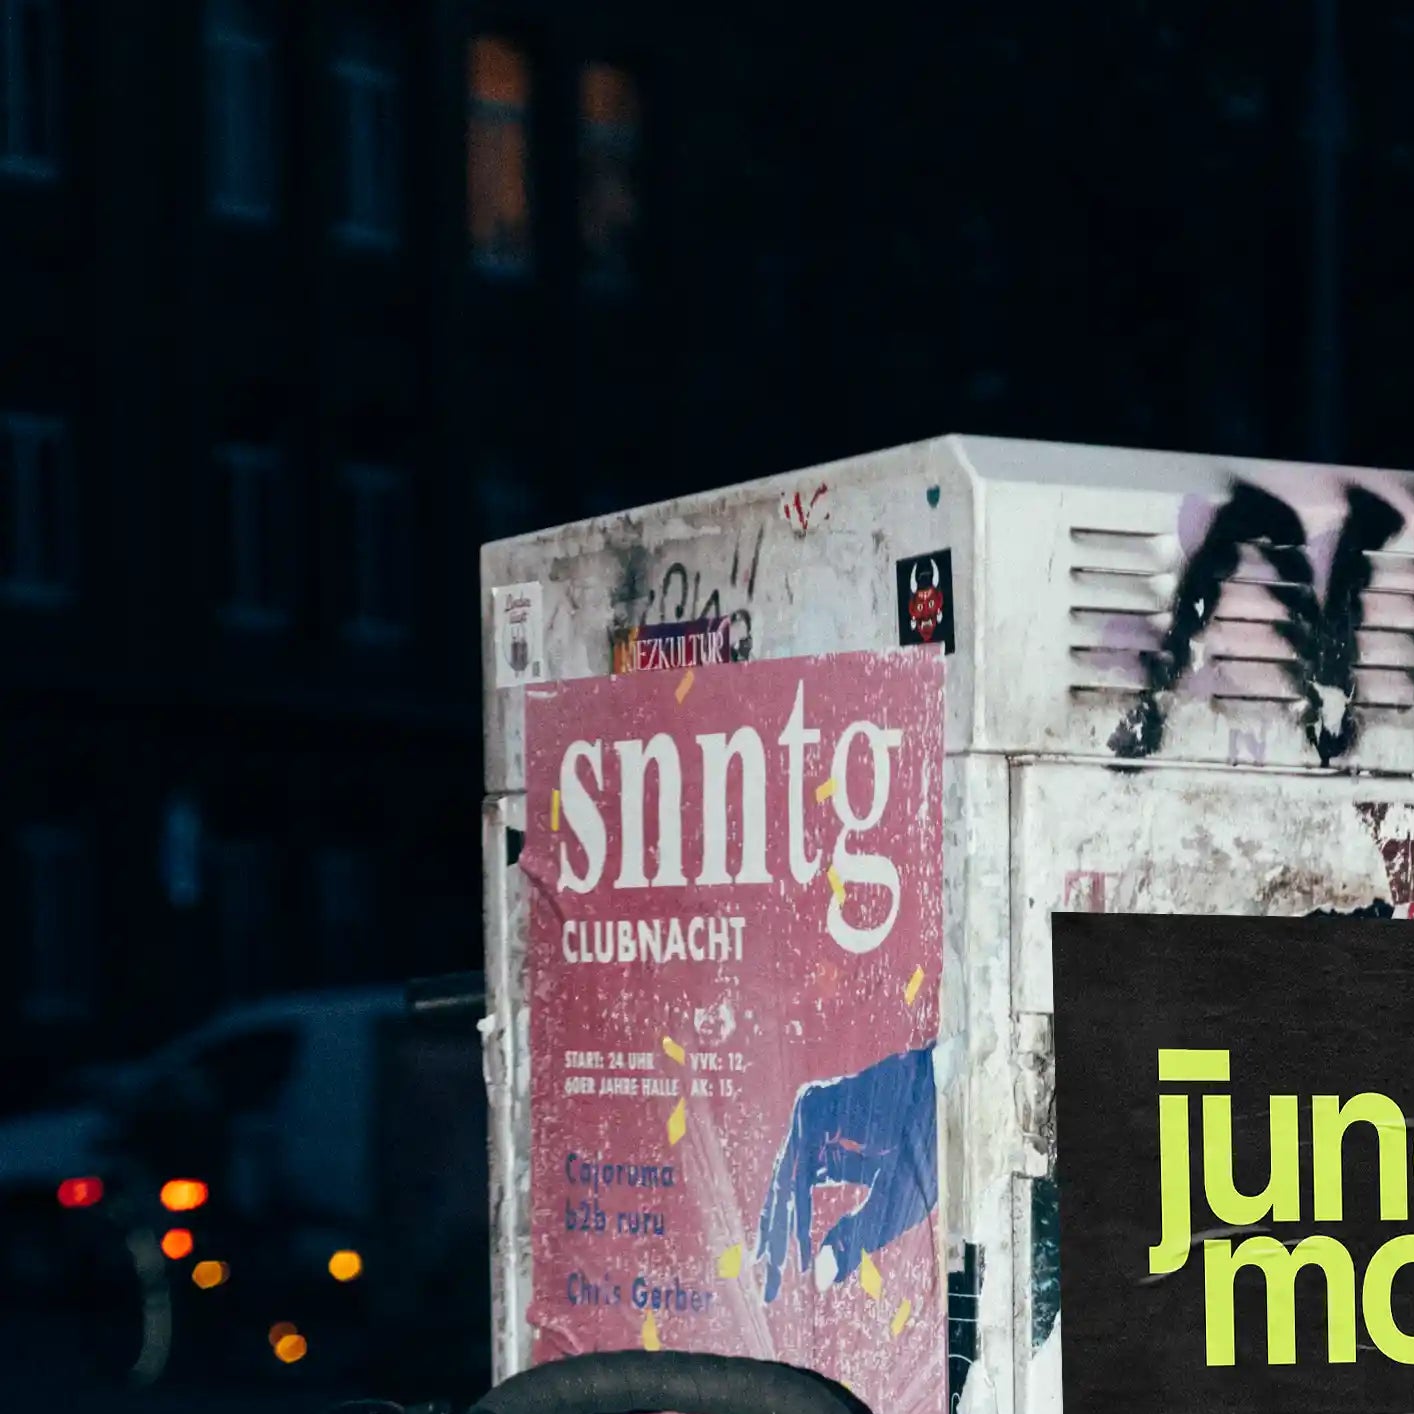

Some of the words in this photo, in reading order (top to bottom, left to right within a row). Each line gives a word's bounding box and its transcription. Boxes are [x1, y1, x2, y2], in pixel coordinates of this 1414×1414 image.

[557, 680, 904, 953] snntg
[562, 916, 746, 964] CLUBNACHT
[564, 1051, 604, 1069] START:
[608, 1052, 624, 1069] 24
[627, 1053, 655, 1070] UHR
[690, 1053, 723, 1072] VVK:
[599, 1078, 638, 1096] JAHRE
[641, 1078, 680, 1098] HALLE
[690, 1079, 714, 1098] AK:
[564, 1200, 607, 1232] b2b
[617, 1211, 665, 1236] ruru
[567, 1271, 621, 1305] Chris
[632, 1276, 714, 1312] Gerber
